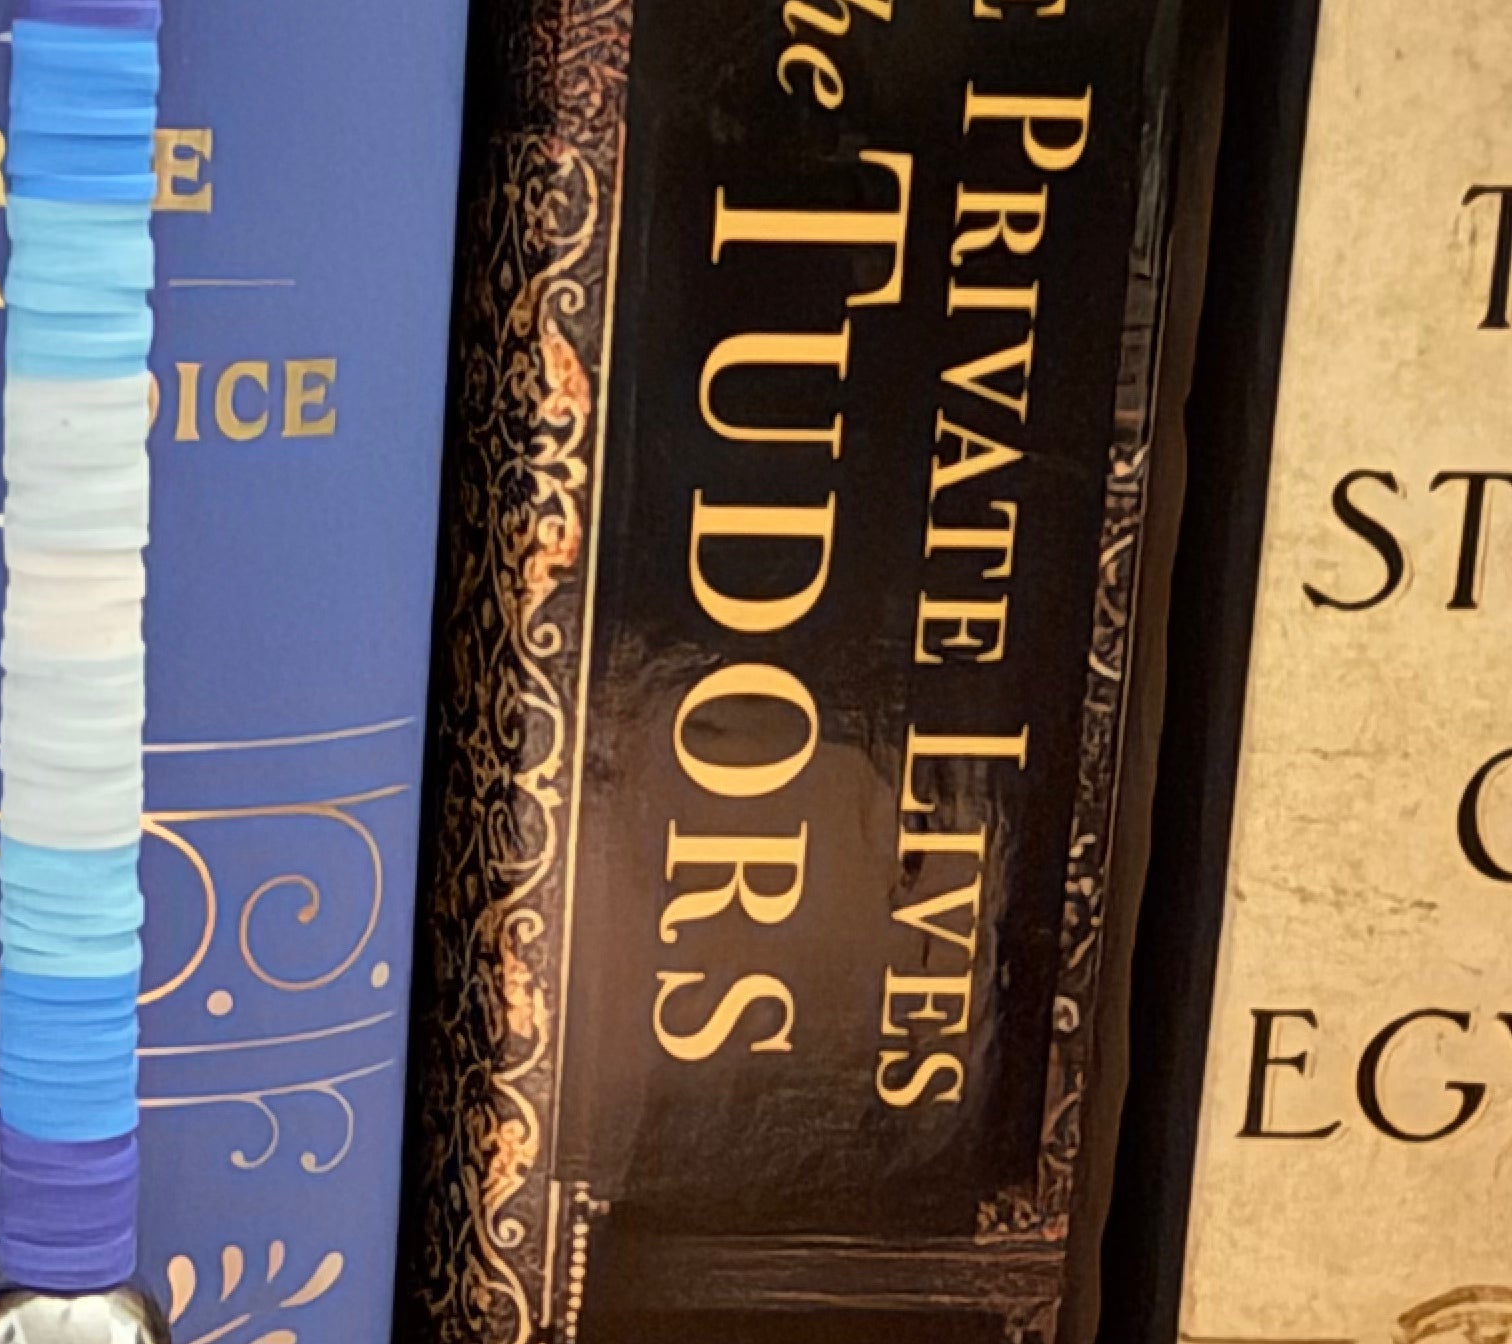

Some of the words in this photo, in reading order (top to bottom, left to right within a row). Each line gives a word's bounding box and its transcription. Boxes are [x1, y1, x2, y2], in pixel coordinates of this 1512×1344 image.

[652, 149, 913, 1061] TUDORS
[912, 81, 1093, 665] PRIVATE
[876, 724, 1029, 1107] LIVES
